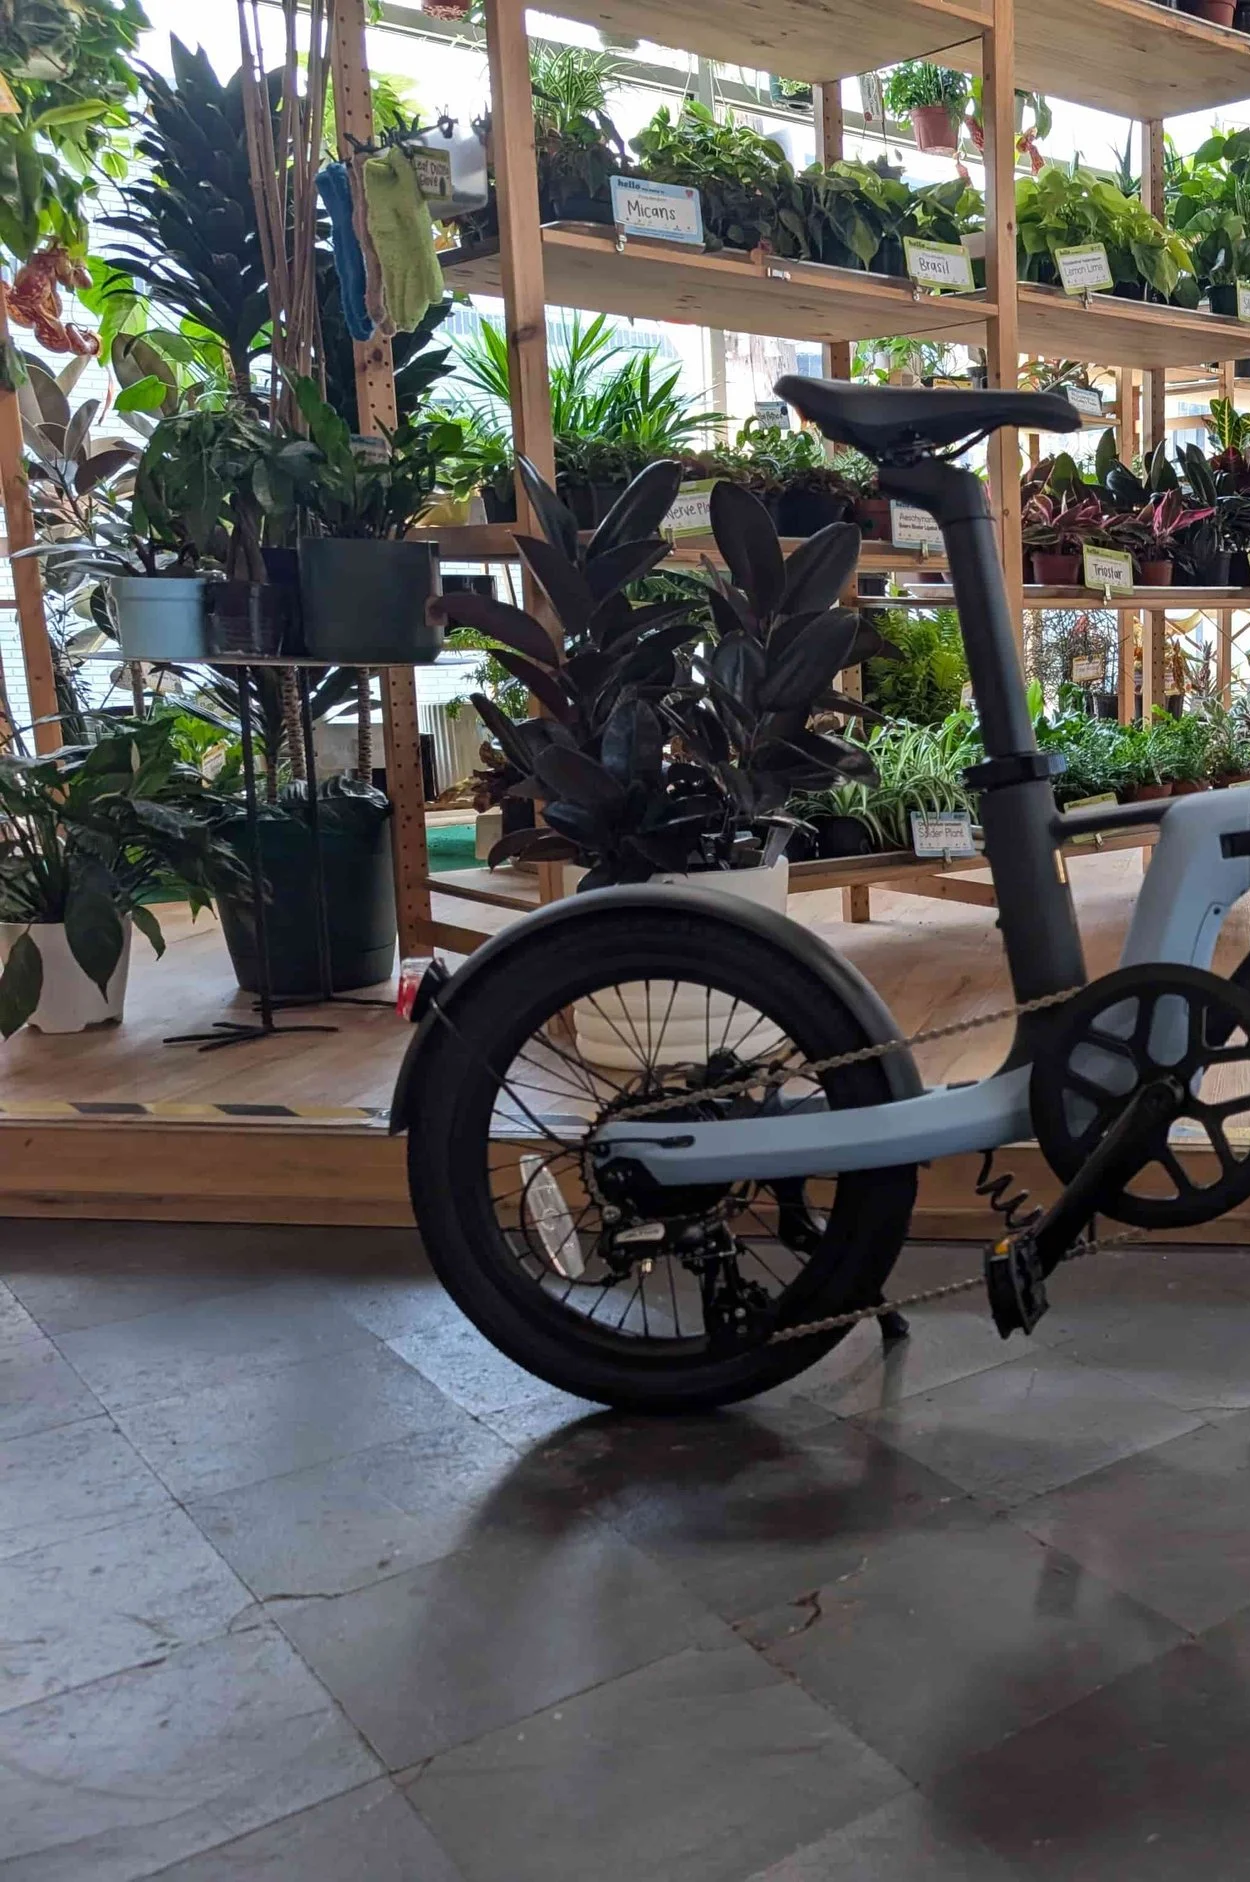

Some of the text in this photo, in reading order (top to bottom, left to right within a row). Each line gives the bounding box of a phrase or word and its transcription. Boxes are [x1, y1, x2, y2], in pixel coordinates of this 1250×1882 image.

[618, 179, 640, 190] hello
[627, 200, 676, 220] Micans
[919, 257, 950, 275] Brasil
[665, 502, 710, 520] Nerve Pla
[1092, 563, 1123, 580] Triostar
[945, 828, 964, 838] Plant
